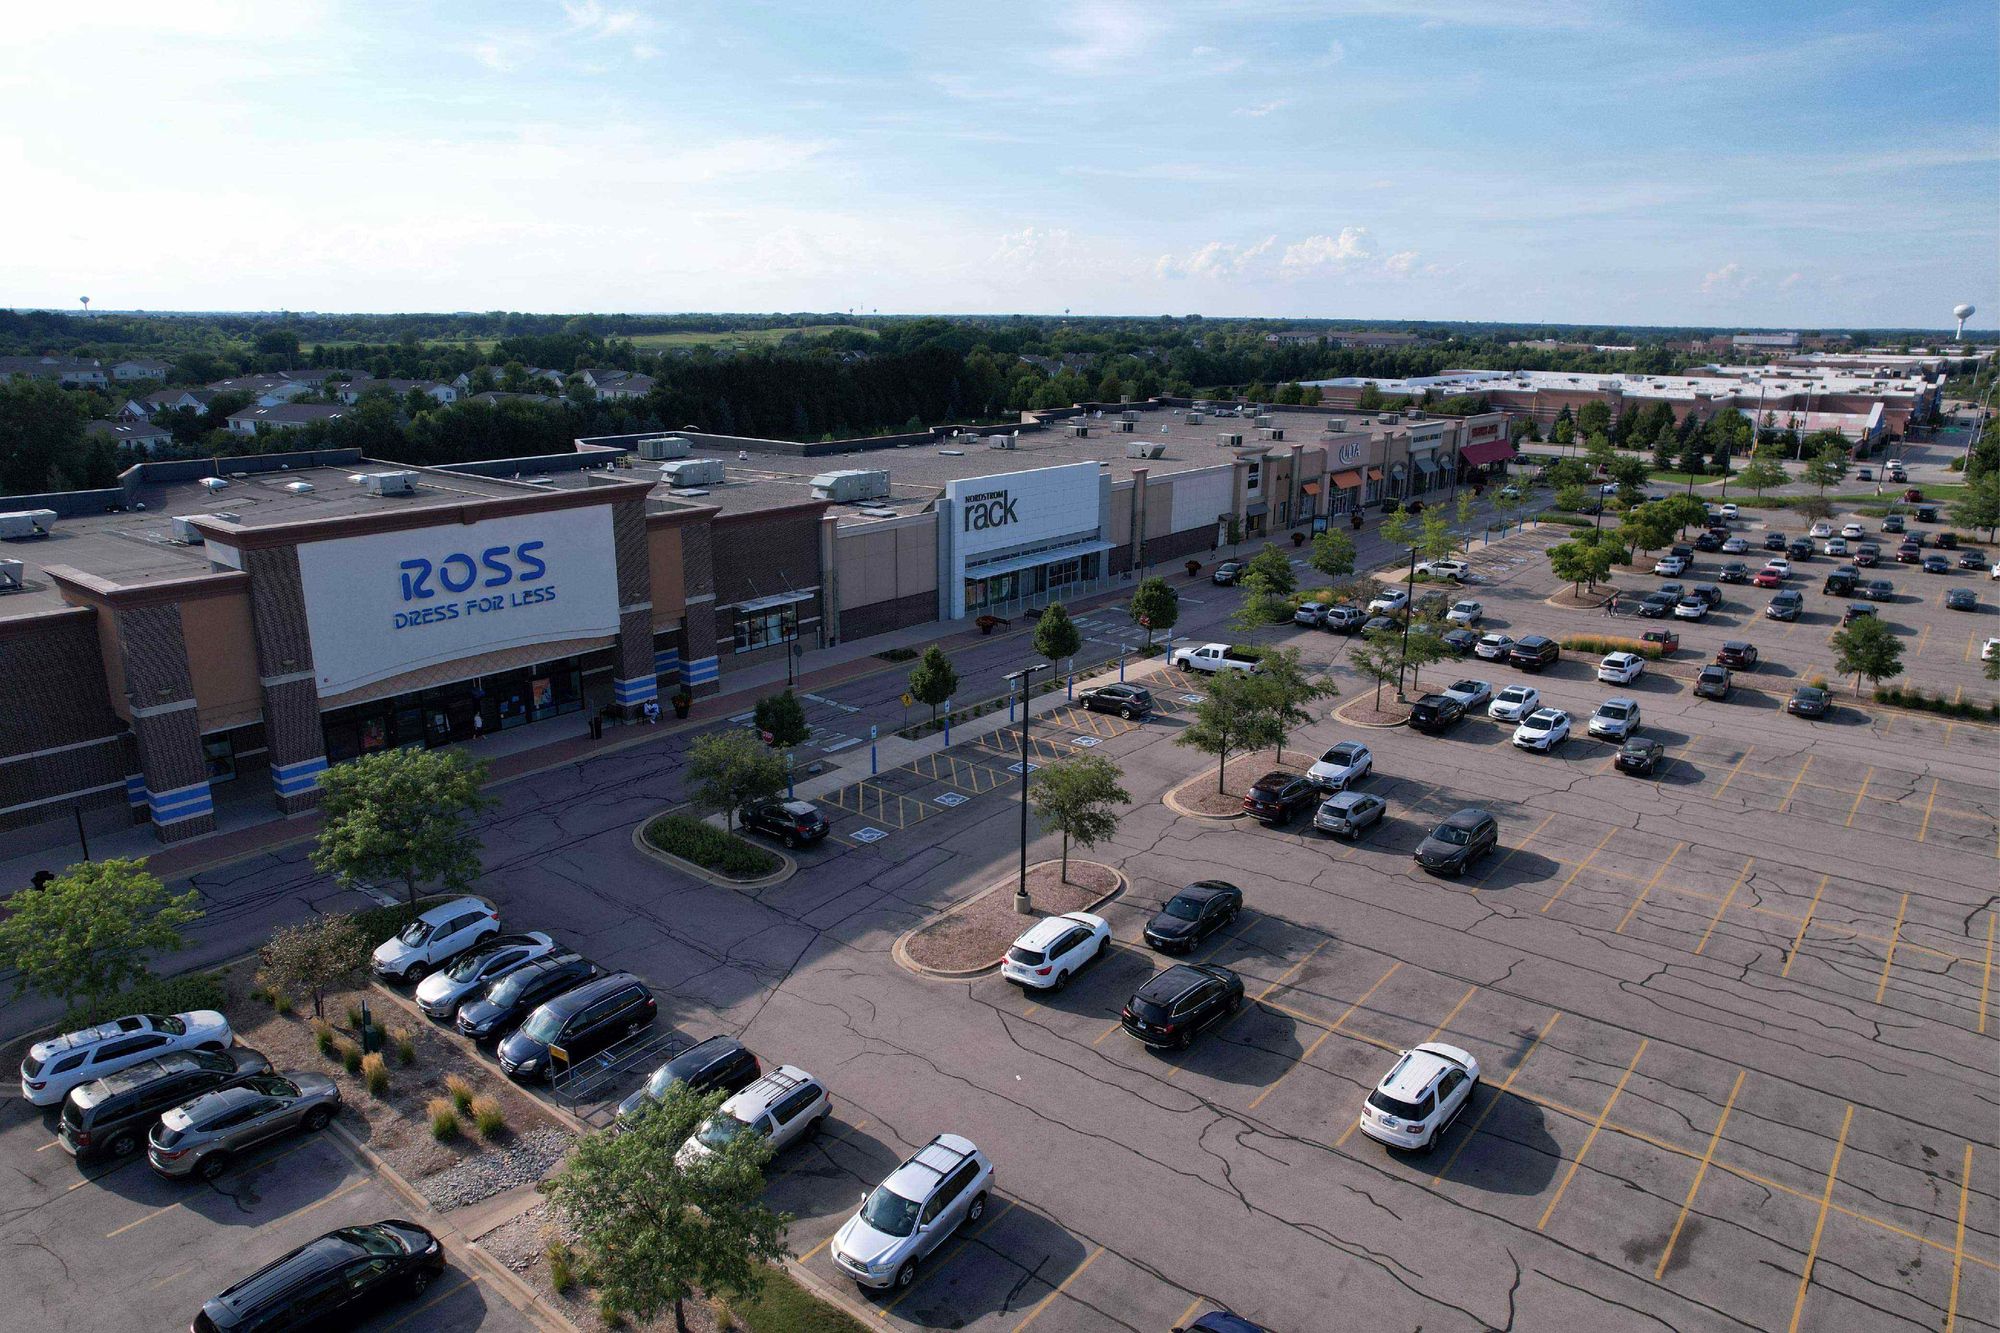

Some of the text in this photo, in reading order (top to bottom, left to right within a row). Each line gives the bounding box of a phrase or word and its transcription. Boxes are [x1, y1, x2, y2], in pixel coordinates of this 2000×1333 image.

[1340, 441, 1360, 460] ULTA
[965, 490, 1003, 503] NORDSTROM
[965, 489, 1018, 532] rack
[400, 540, 546, 601] ROSS
[394, 586, 556, 629] DRESS FOR LESS
